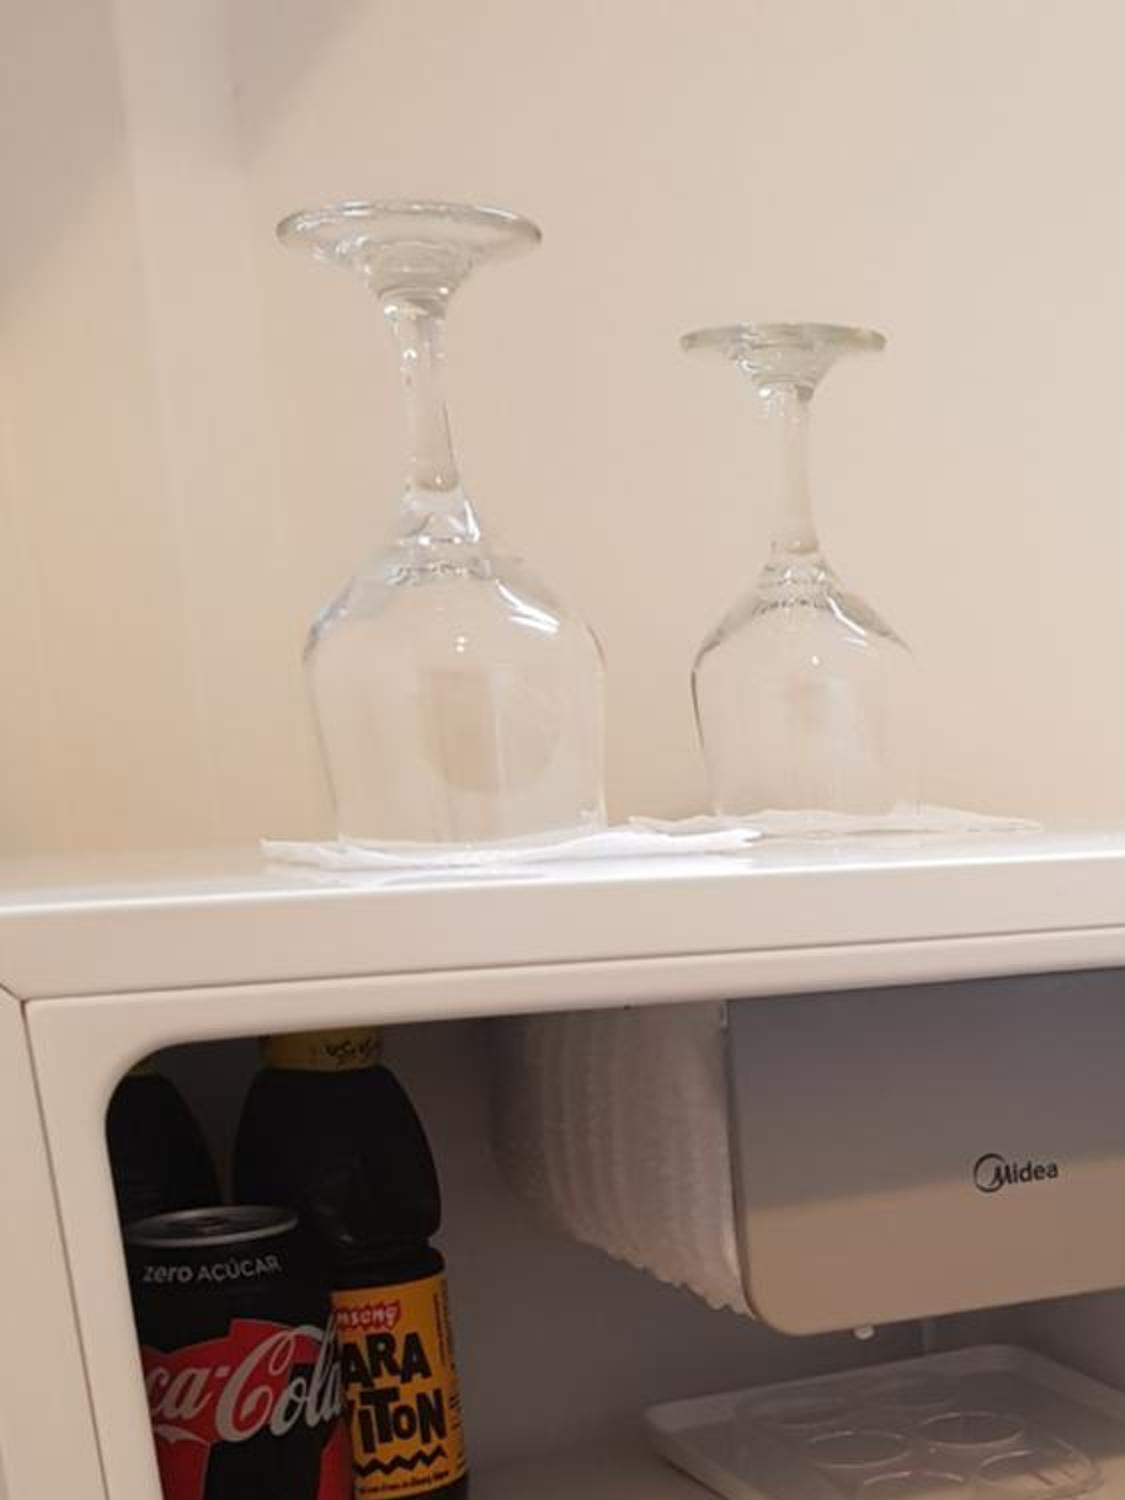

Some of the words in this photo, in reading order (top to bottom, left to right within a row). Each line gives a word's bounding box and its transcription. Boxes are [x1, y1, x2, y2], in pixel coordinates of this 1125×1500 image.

[974, 1153, 1059, 1192] Midea
[143, 1264, 193, 1283] zero
[198, 1254, 283, 1282] AÇÚCAR
[147, 1312, 343, 1442] ca-Cola
[343, 1331, 432, 1389] ARA
